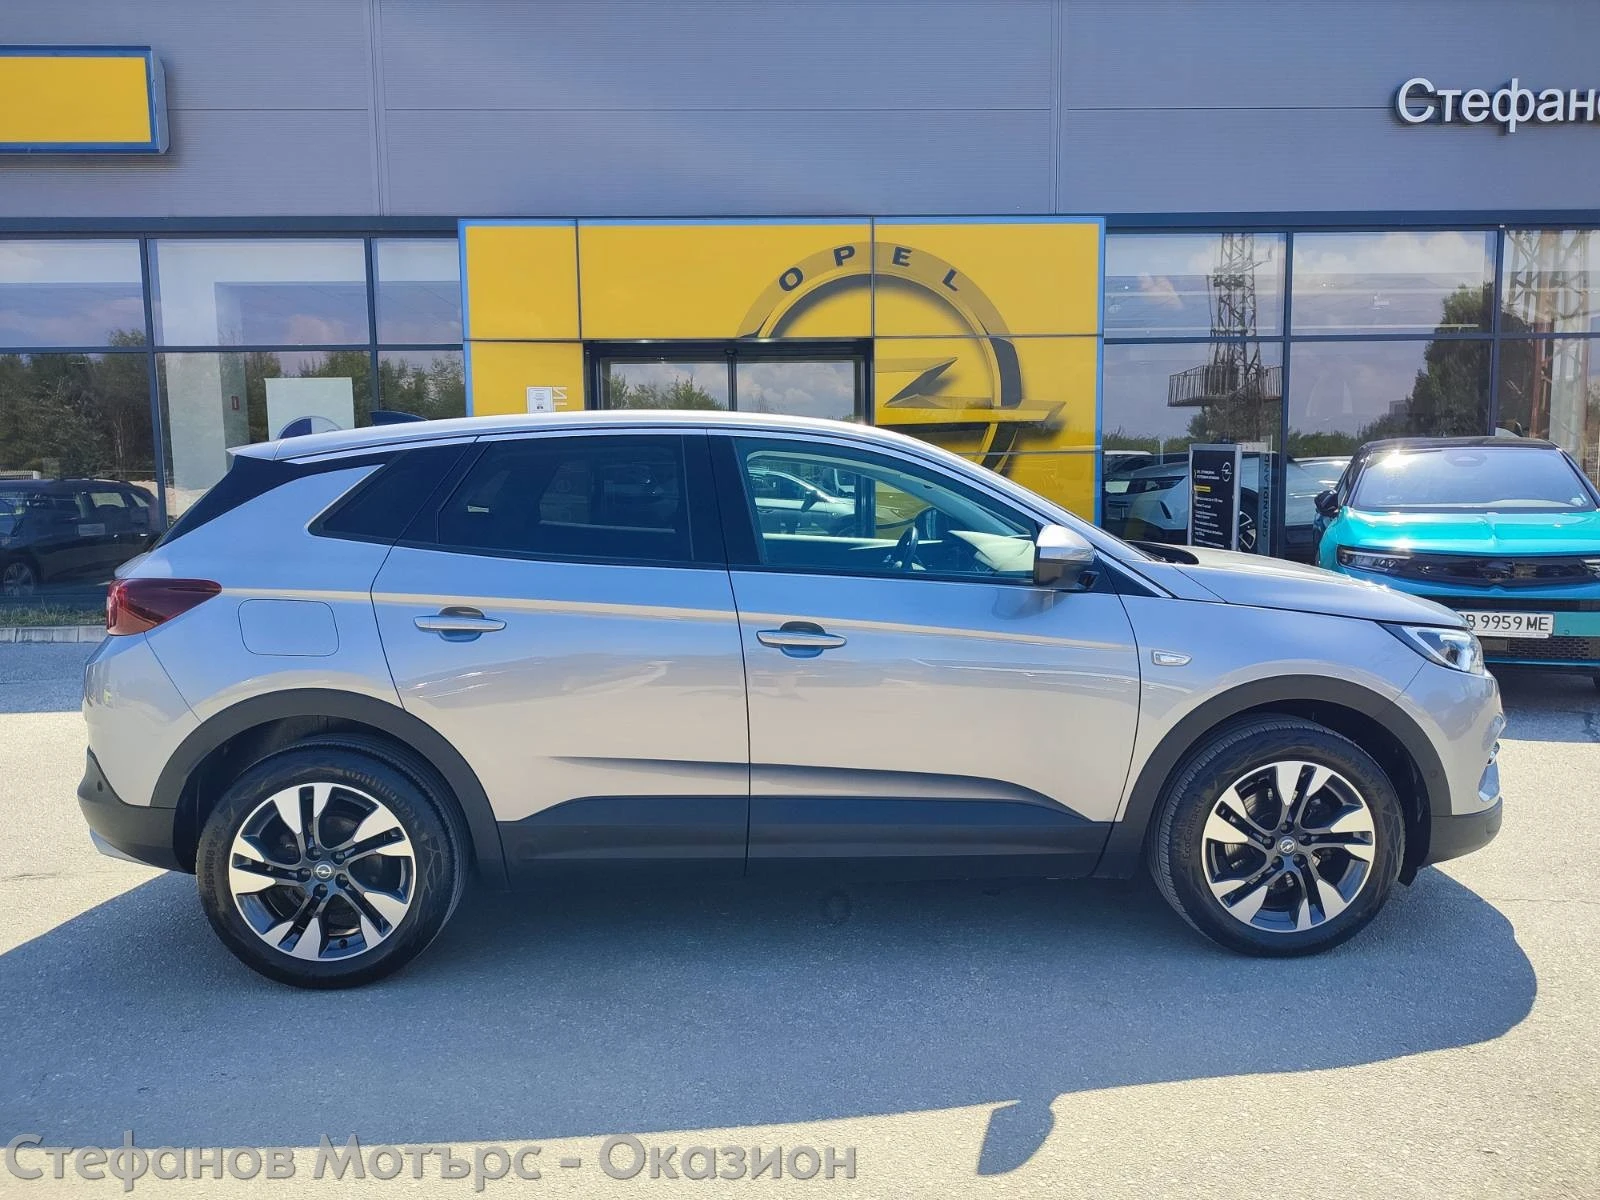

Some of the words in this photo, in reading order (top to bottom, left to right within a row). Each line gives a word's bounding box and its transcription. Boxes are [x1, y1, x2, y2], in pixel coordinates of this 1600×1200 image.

[1398, 77, 1600, 133] Стефан
[779, 245, 961, 292] OPEL
[1481, 614, 1523, 631] 9959
[1526, 616, 1549, 631] ME
